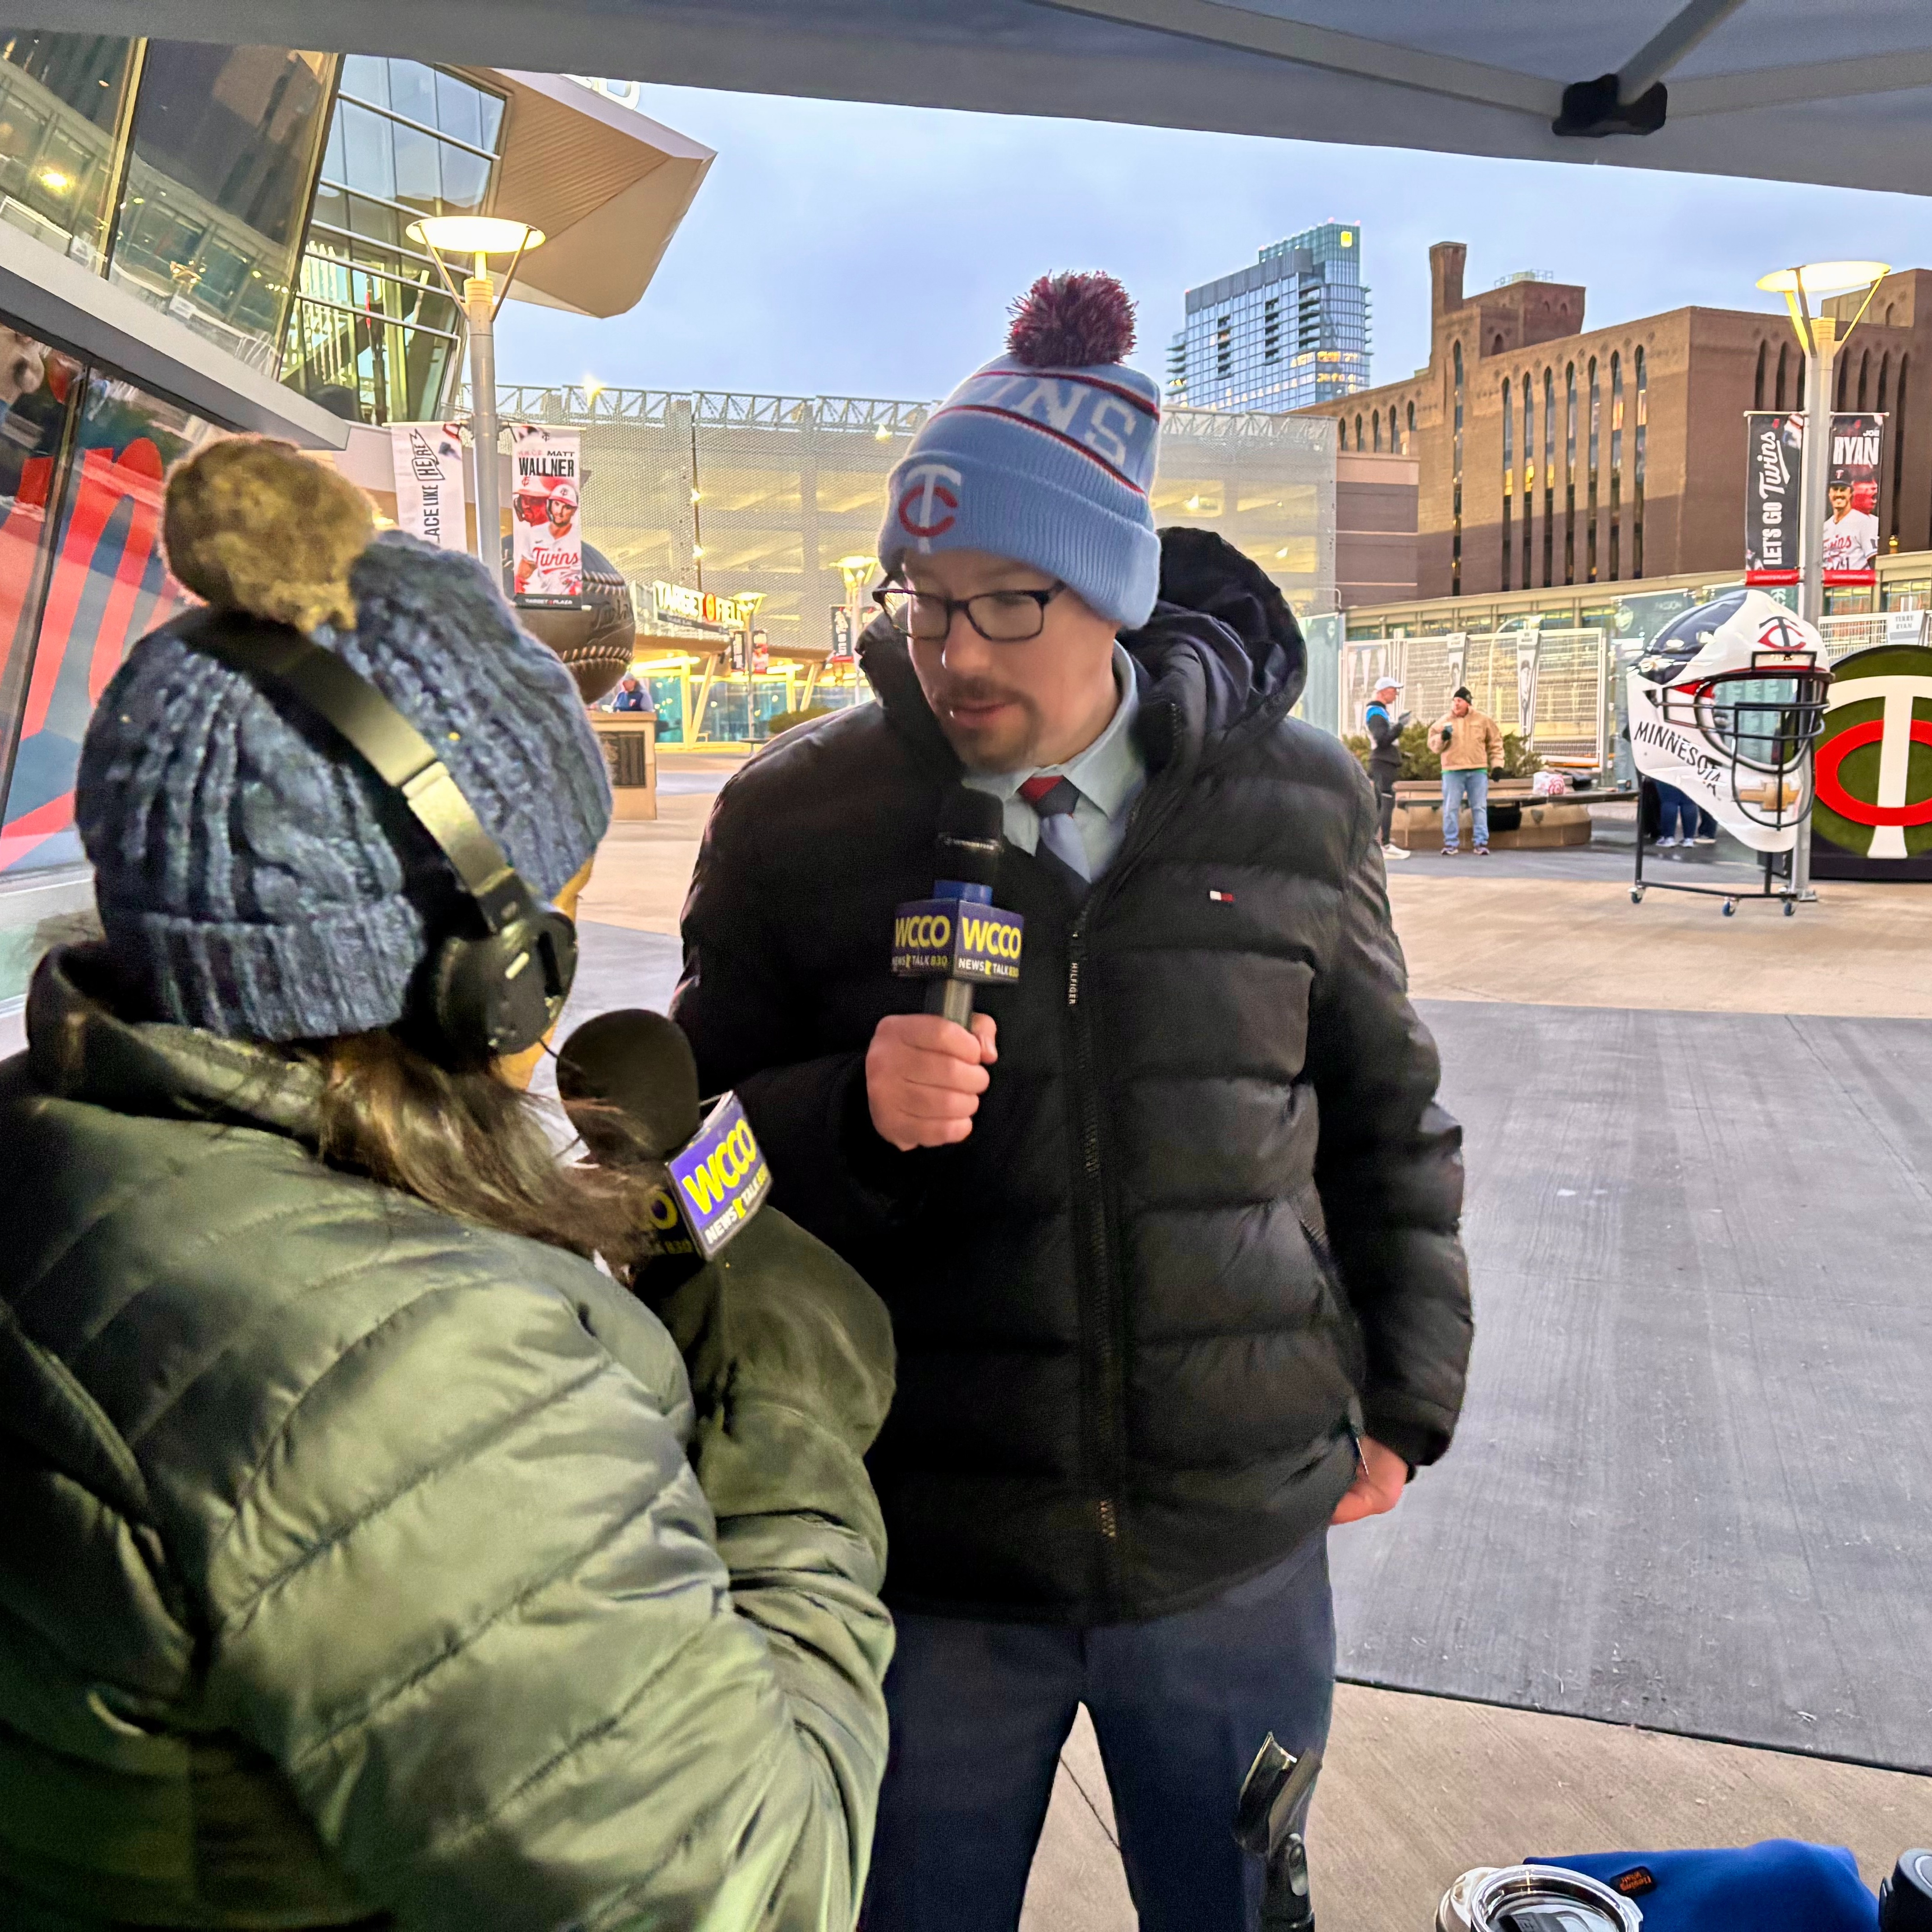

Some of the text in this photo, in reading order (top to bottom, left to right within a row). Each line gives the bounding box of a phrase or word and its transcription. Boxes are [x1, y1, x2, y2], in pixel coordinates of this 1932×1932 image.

[519, 457, 574, 477] WALLNER
[1757, 431, 1789, 499] Twins
[1833, 437, 1880, 465] RYAN
[422, 484, 439, 506] LIKE
[1762, 502, 1782, 524] GO
[533, 547, 579, 571] Twins
[1762, 529, 1782, 565] LET'S
[653, 580, 705, 622] TARGET
[1634, 721, 1721, 797] MINNESOTA
[895, 915, 951, 948] WCCO
[962, 916, 1022, 959] WCCO
[912, 955, 930, 966] TALK
[930, 955, 948, 967] 830
[958, 957, 985, 972] NEWS
[993, 963, 1009, 975] TALK
[1069, 962, 1078, 1004] HILFIGER
[682, 1119, 756, 1214] WCCO
[704, 1205, 738, 1244] NEWS
[741, 1177, 760, 1206] TALK
